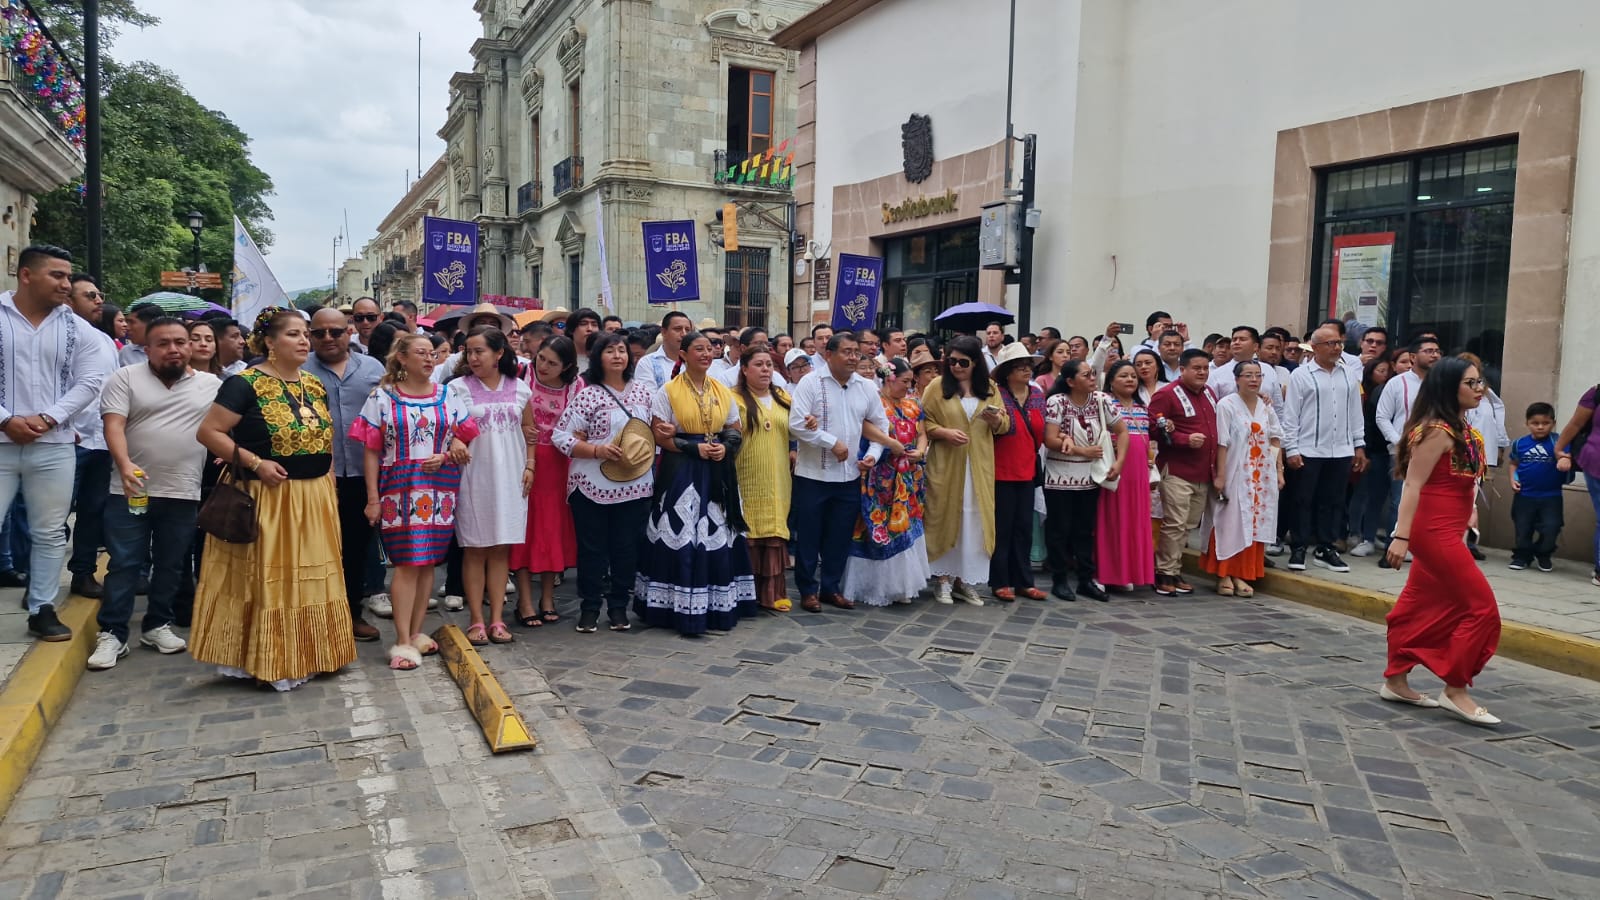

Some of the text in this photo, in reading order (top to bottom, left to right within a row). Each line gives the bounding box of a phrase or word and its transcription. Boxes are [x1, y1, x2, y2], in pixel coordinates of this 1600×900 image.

[881, 188, 958, 224] Scotiabank
[447, 231, 471, 246] FBA
[665, 231, 689, 245] FBA
[856, 267, 876, 281] FBA
